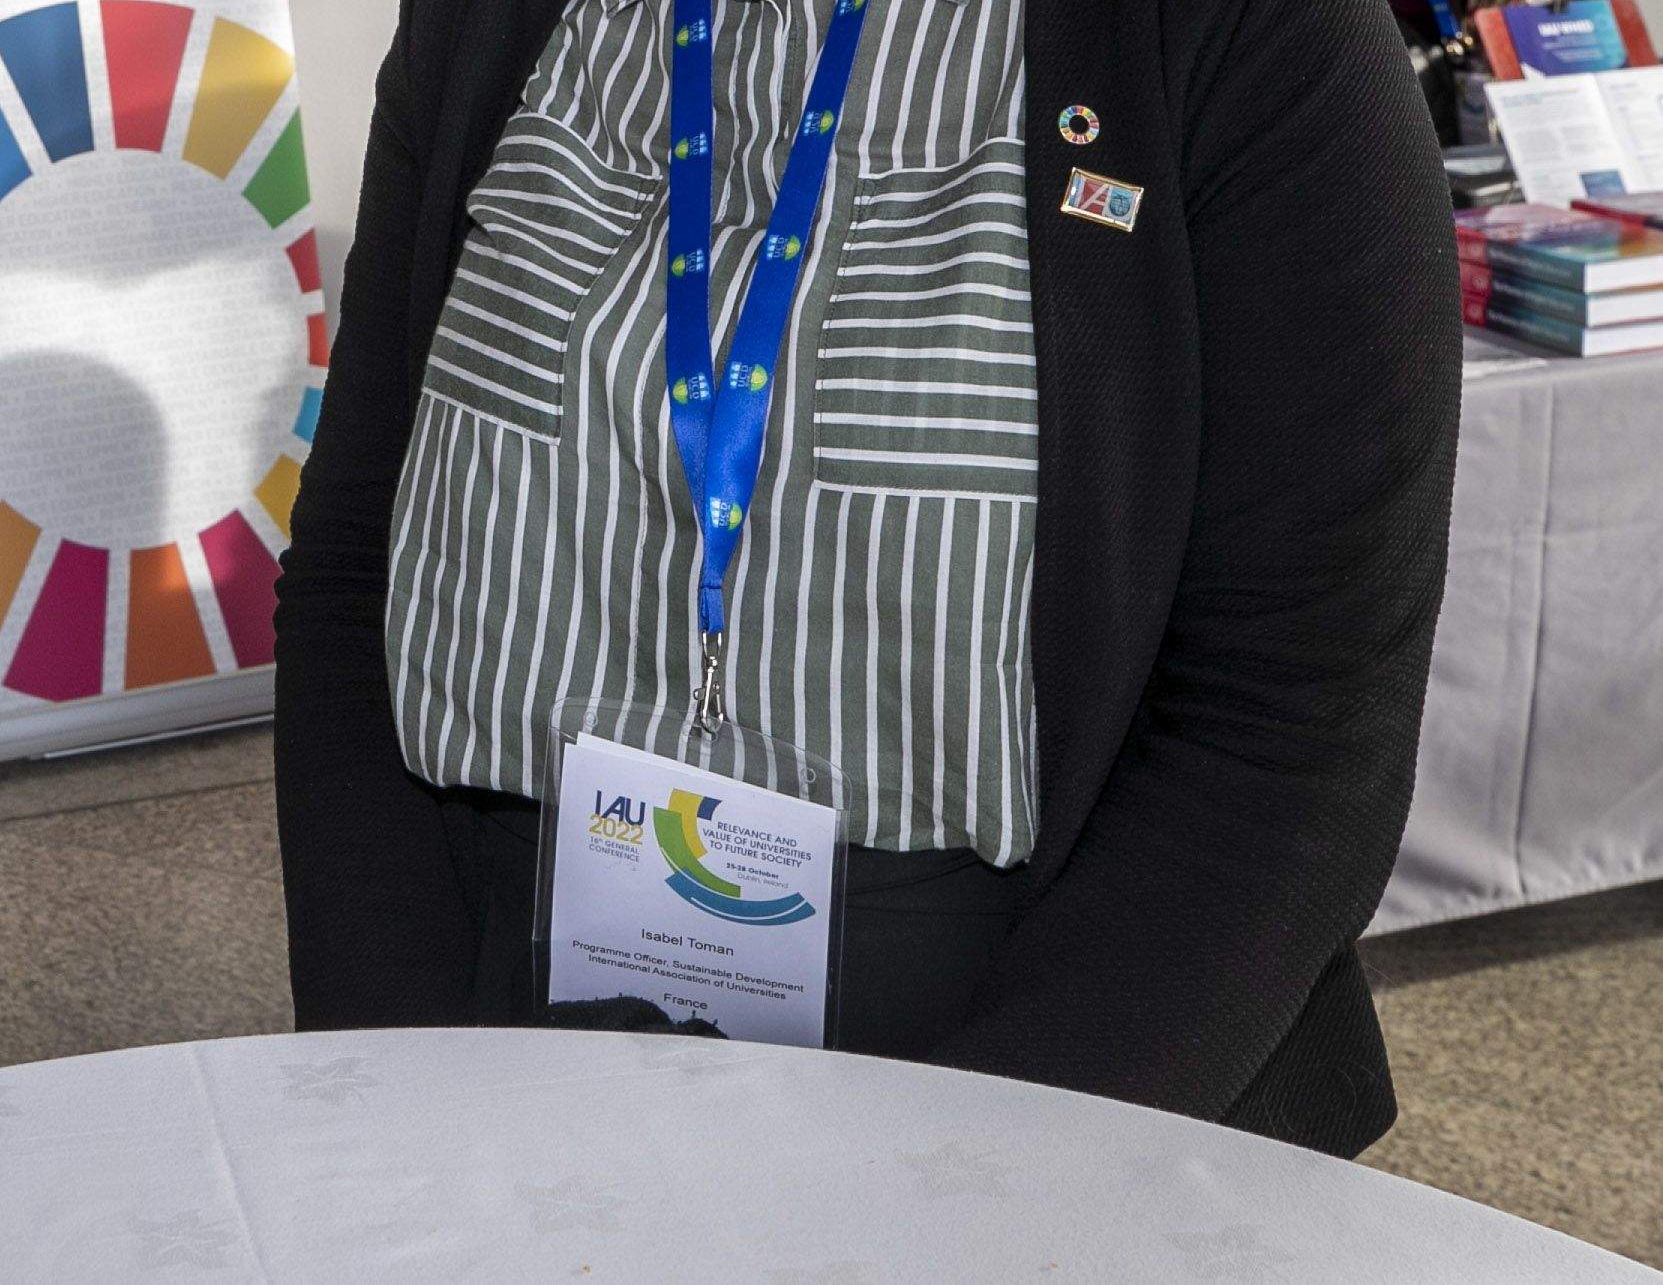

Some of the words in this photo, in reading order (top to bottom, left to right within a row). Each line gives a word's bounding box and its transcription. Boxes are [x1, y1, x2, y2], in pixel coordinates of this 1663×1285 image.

[594, 790, 646, 827] IAU
[588, 814, 644, 846] 2022
[717, 821, 773, 842] RELEVANCE
[775, 835, 797, 848] AND
[588, 844, 640, 863] CONFERENCE
[604, 839, 640, 855] GENERAL
[702, 828, 732, 843] VALUE
[734, 835, 749, 846] OF
[750, 840, 812, 862] UNIVERSITIES
[710, 840, 724, 850] TO
[725, 844, 759, 860] FUTURE
[761, 851, 803, 868] SOCIETY
[748, 867, 780, 880] October
[641, 928, 683, 947] Isabel
[687, 937, 734, 957] Toman
[572, 939, 631, 959] Programme
[633, 952, 669, 967] Officer,
[672, 960, 733, 979] Sustainable
[735, 971, 804, 993] Development
[587, 954, 651, 974] International
[652, 966, 712, 986] Association
[713, 979, 725, 989] of
[726, 981, 787, 1000] Universities
[662, 992, 708, 1010] France
